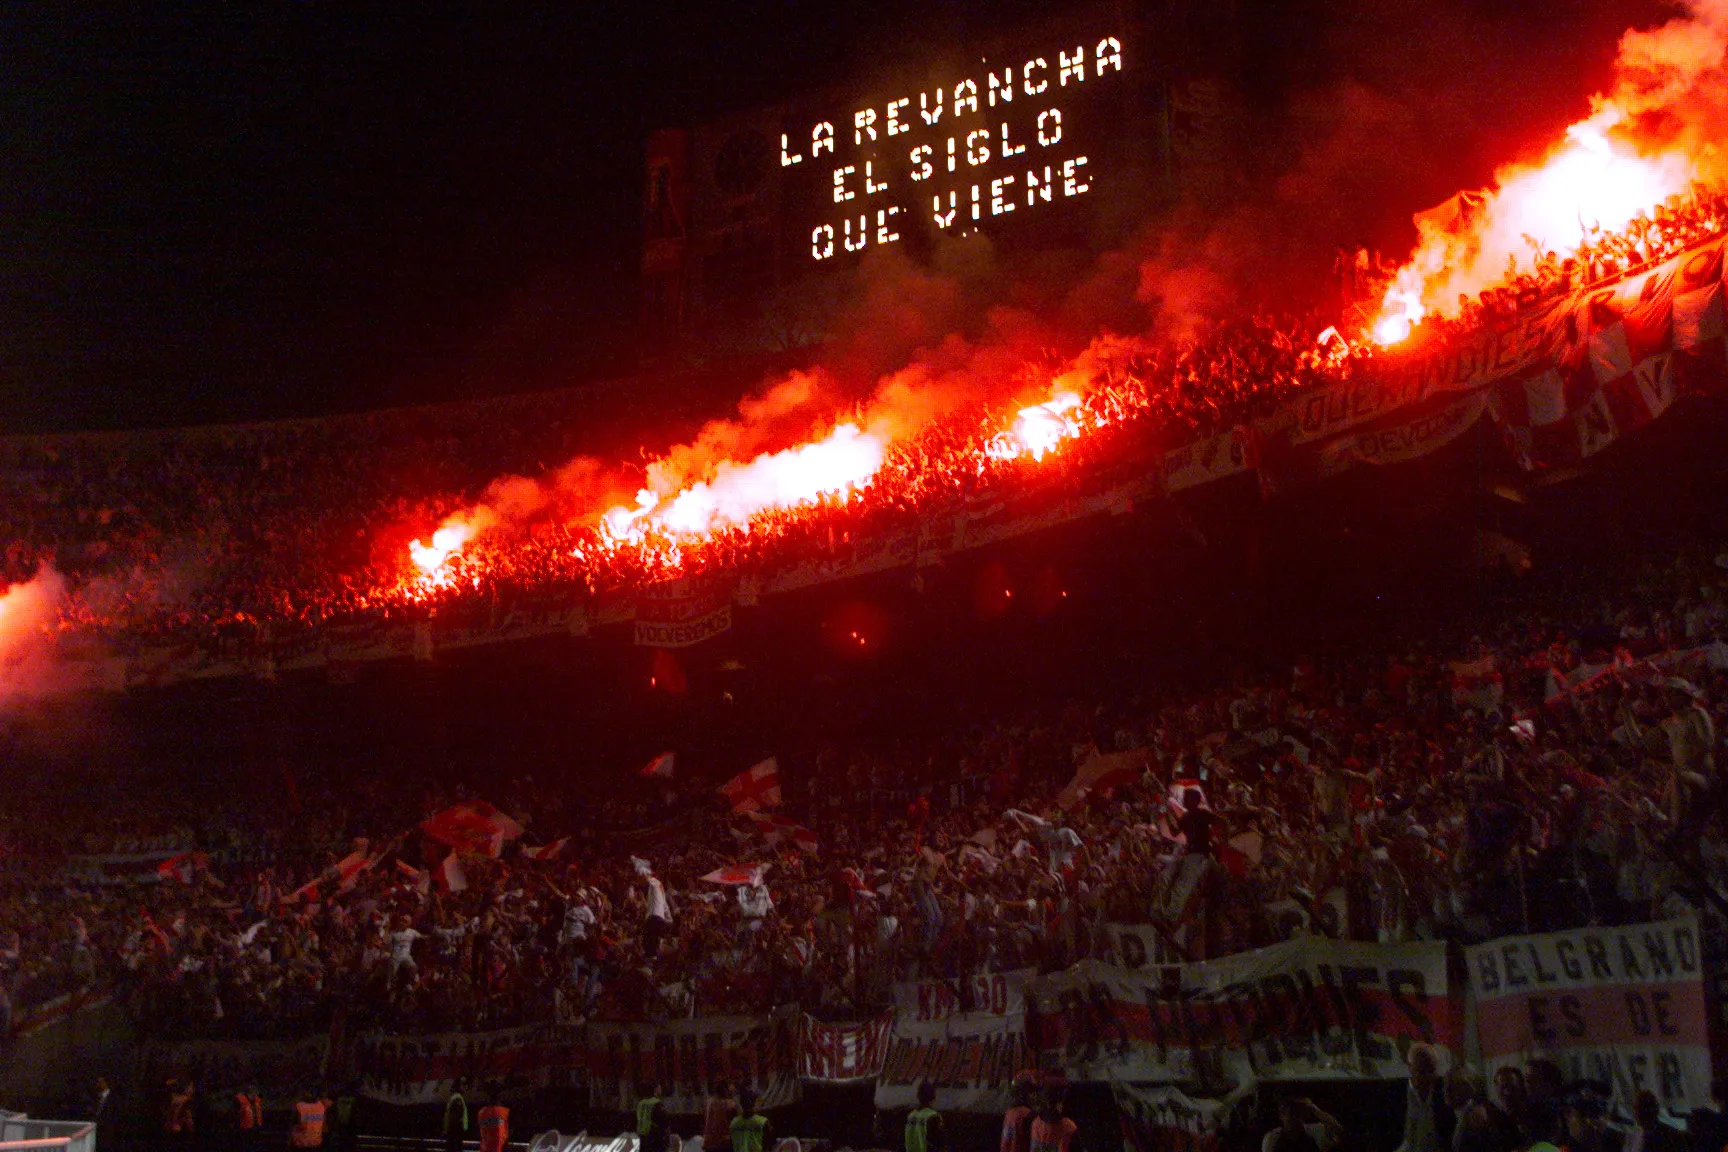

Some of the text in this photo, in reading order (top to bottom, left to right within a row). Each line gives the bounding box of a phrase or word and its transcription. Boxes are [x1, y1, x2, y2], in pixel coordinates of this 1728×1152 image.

[780, 36, 1121, 167] LA REVANCHA
[833, 107, 1062, 203] EL SIGLO
[812, 156, 1089, 260] QUE VIENE
[1477, 927, 1697, 993] BELGRANO
[1528, 991, 1680, 1041] ES DE
[1568, 1052, 1684, 1100] IVER
